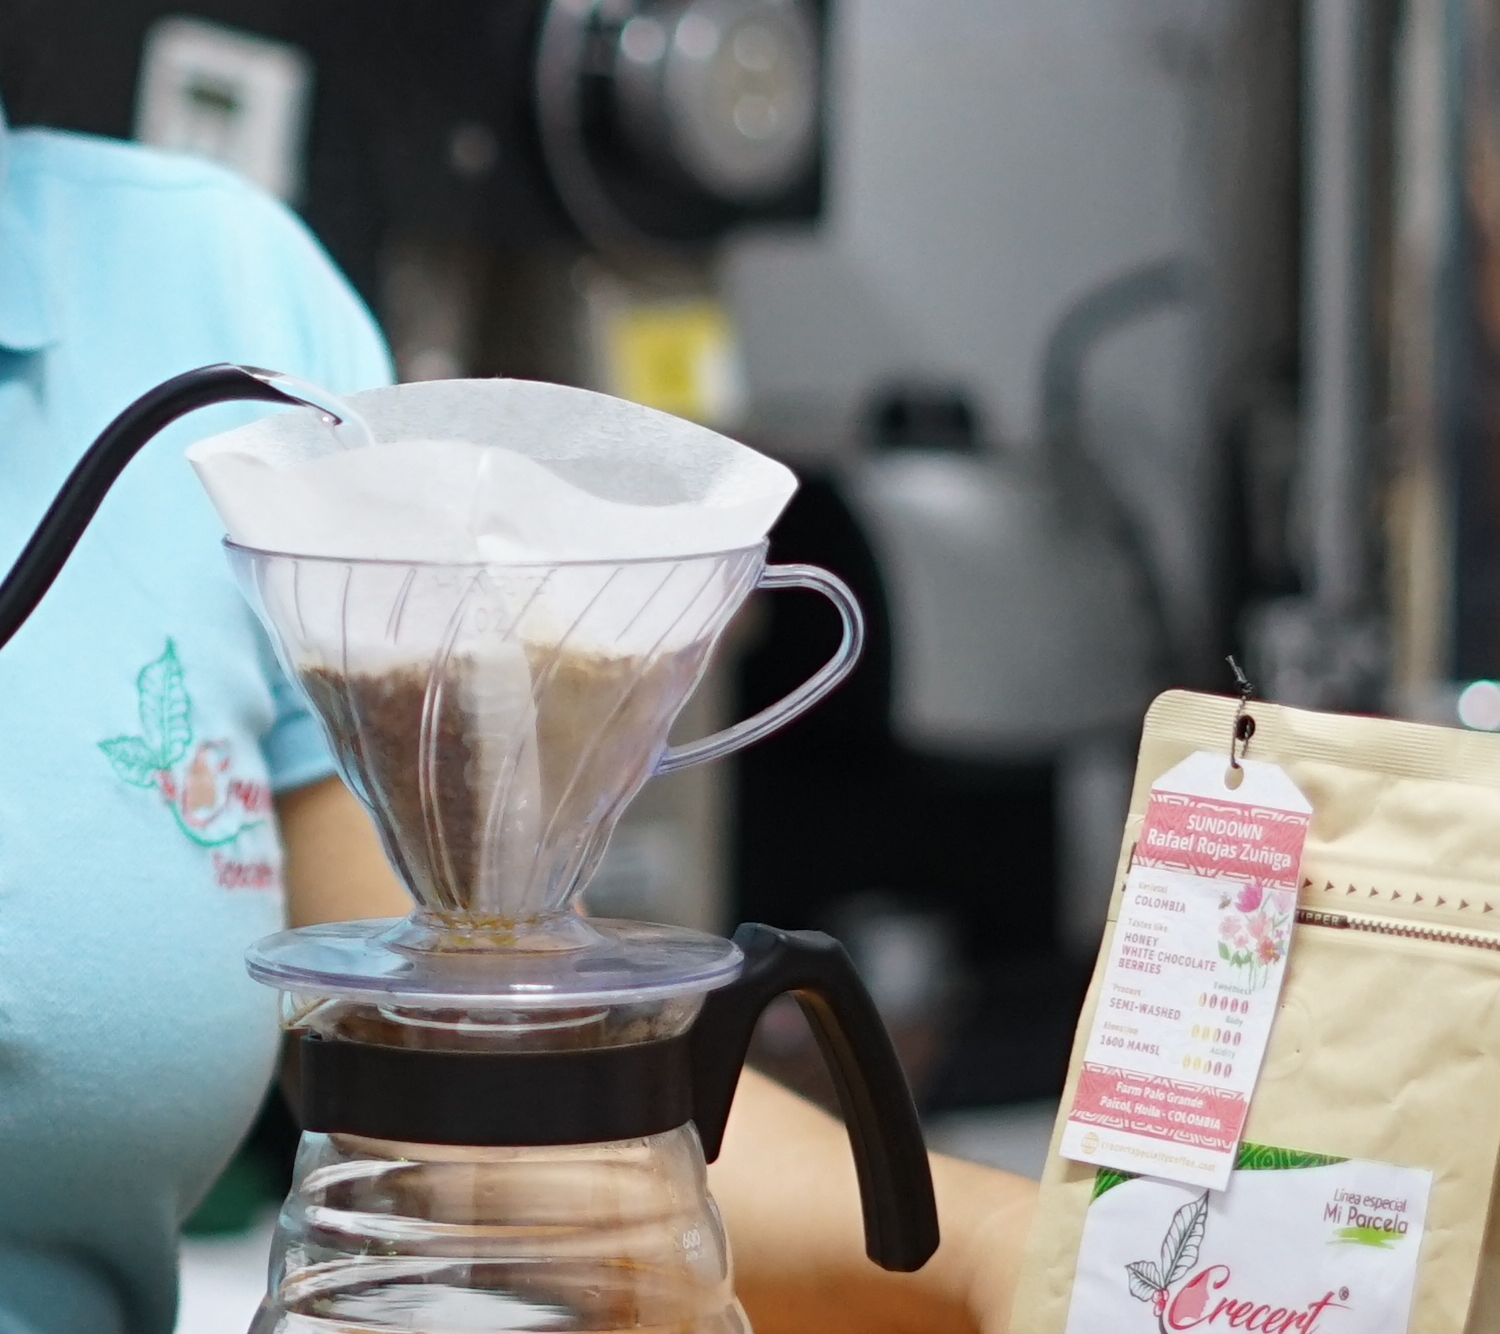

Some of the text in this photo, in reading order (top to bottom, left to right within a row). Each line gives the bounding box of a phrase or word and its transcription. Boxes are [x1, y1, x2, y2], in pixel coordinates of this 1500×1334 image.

[1186, 813, 1264, 841] SUNDOWN
[1146, 827, 1293, 871] Rafael Rojas Zuñiga
[1133, 893, 1188, 914] COLOMBIA
[1123, 931, 1160, 948] HONEY
[1117, 957, 1163, 976] BERRIES
[1121, 943, 1218, 973] WHITE CHOCOLATE
[1108, 996, 1182, 1022] SEMI-WASHED
[1099, 1034, 1161, 1057] 1600 MAMSL
[1115, 1081, 1204, 1110] Farm Palo Grande
[1133, 1100, 1161, 1119] Huila
[1166, 1109, 1222, 1132] COLOMBIA
[1333, 1188, 1408, 1214] Línea especial
[1322, 1202, 1409, 1236] Mi Parcela
[682, 1229, 702, 1250] 600
